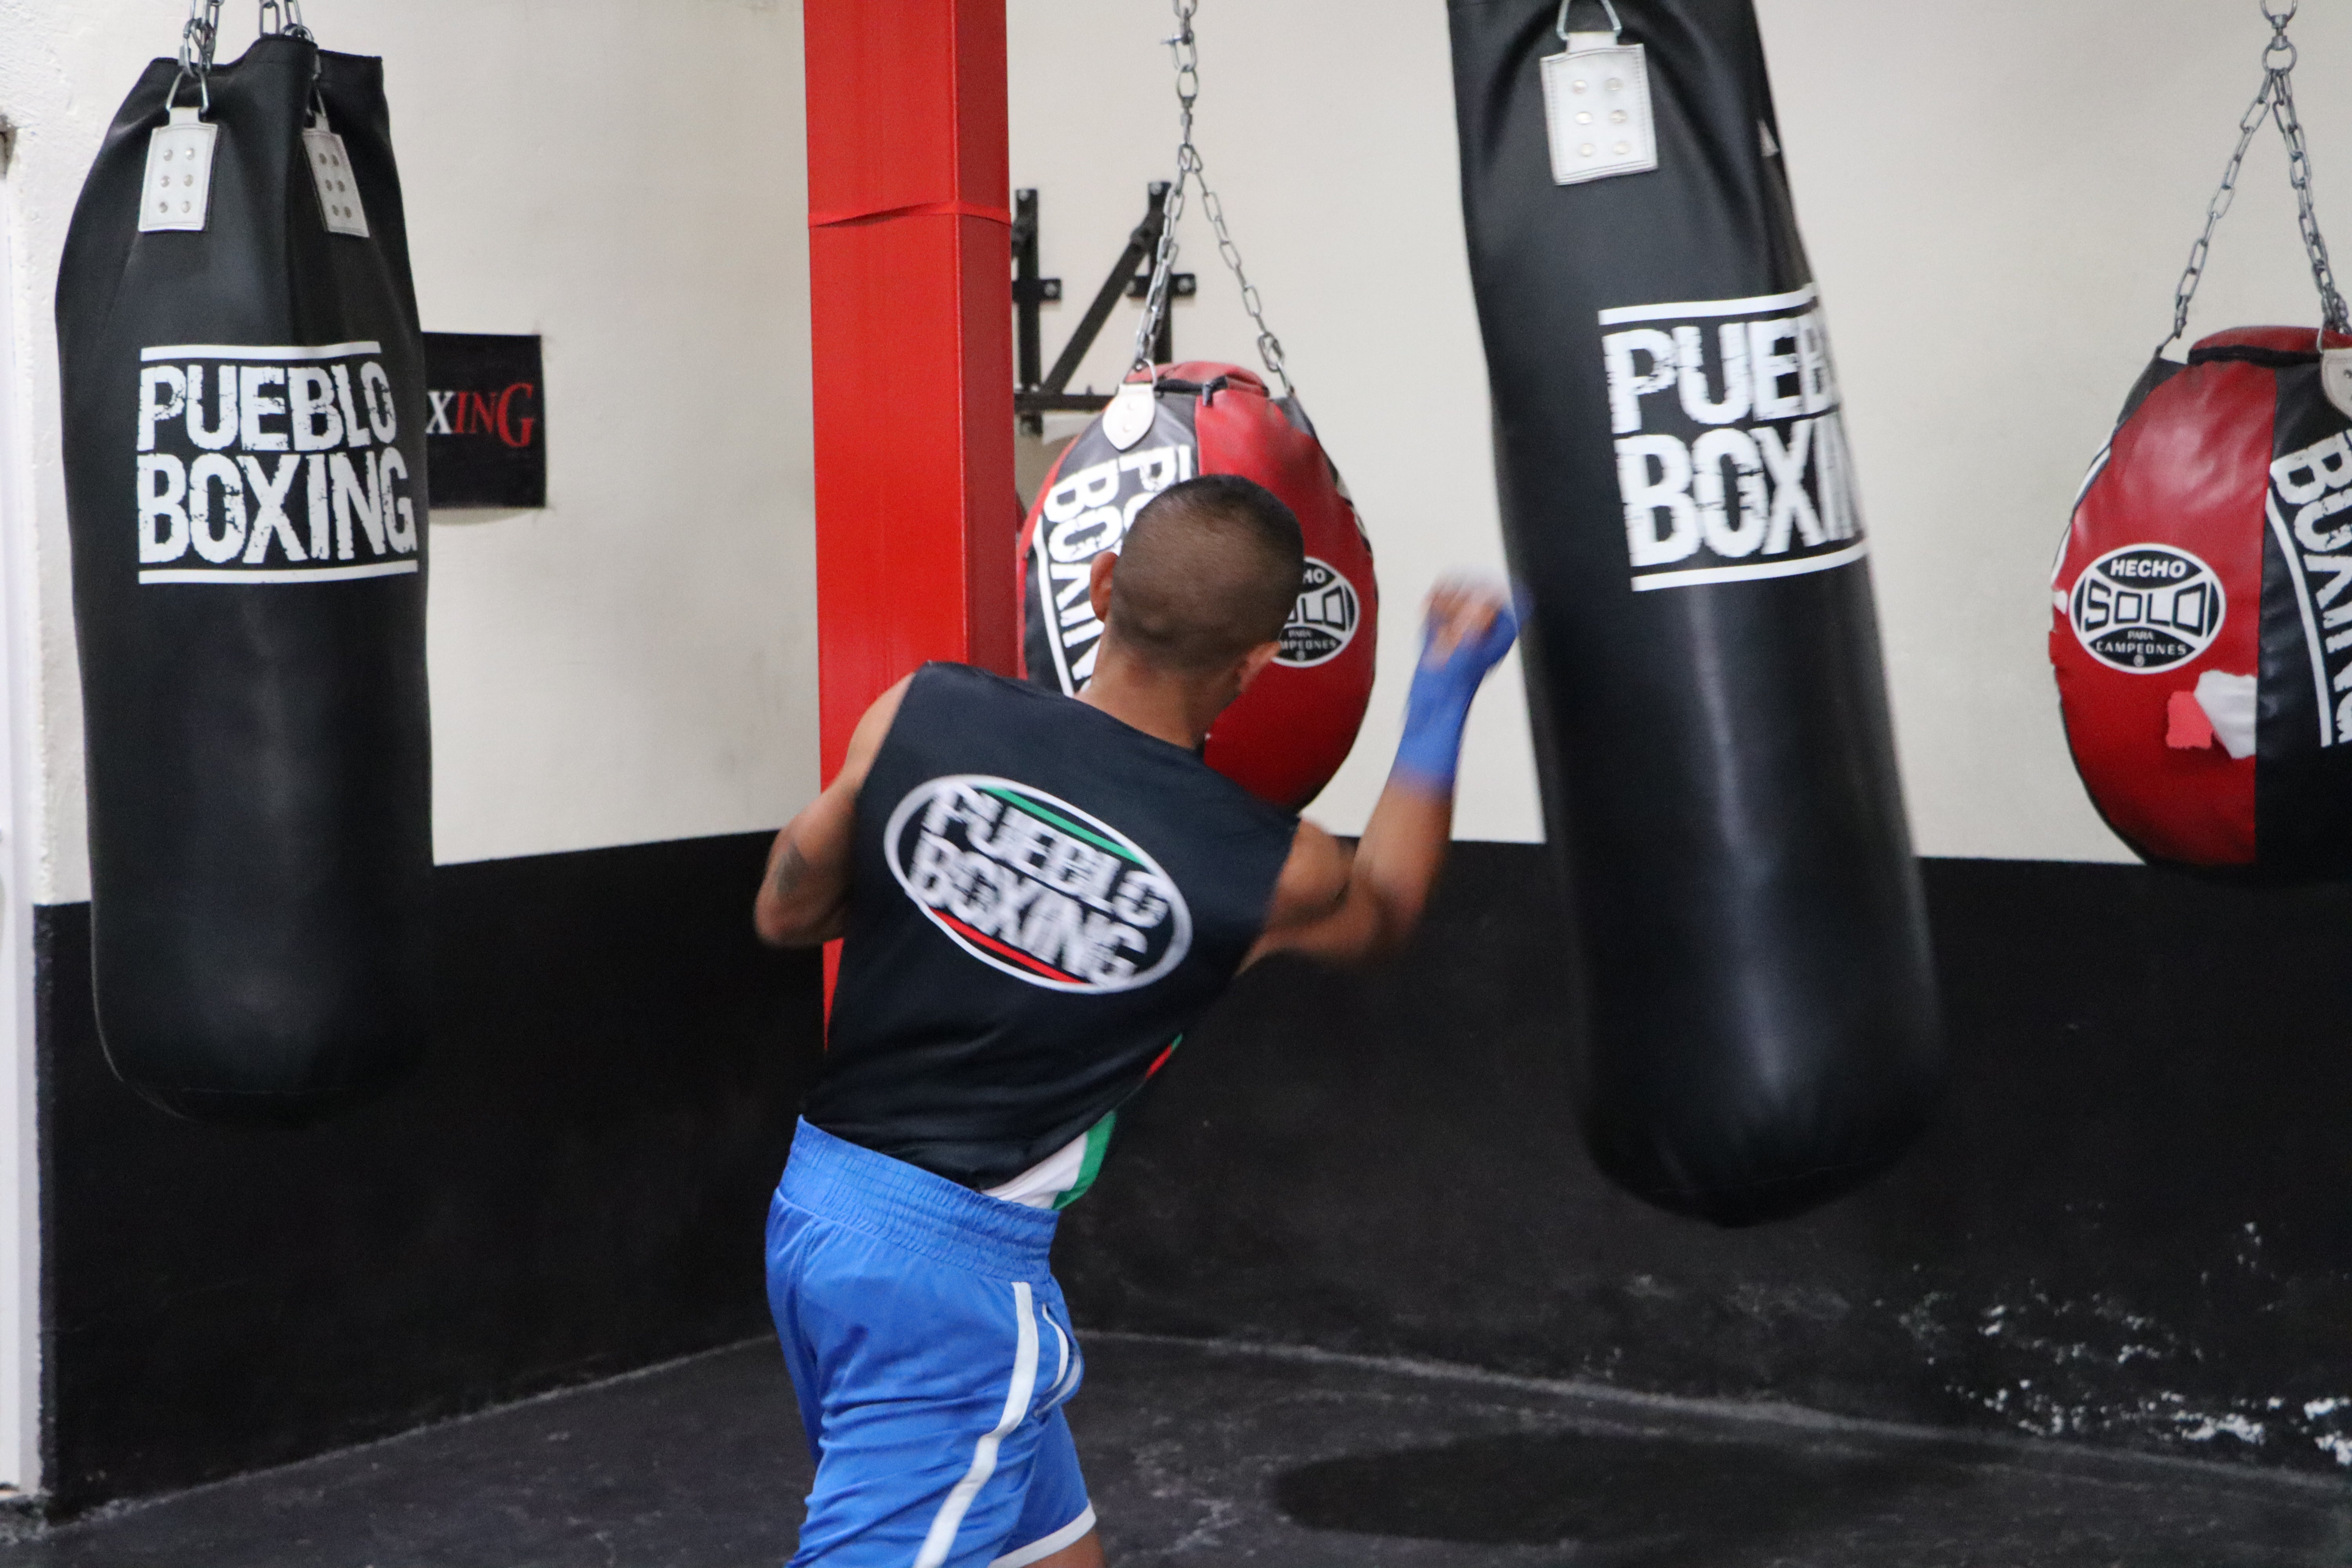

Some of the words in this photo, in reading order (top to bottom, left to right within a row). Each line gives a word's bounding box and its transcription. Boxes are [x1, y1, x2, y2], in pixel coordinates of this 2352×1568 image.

[137, 361, 396, 451] PUEBLO
[1602, 312, 1839, 434] PUEB
[426, 382, 534, 447] XING
[137, 447, 418, 564] BOXING
[1614, 418, 1857, 567] BOXI
[2110, 559, 2187, 578] HECHO
[1279, 639, 1337, 650] MPEONES
[2085, 579, 2207, 637] SOLO
[2127, 630, 2154, 640] PARA
[2096, 641, 2187, 655] CAMPEONES
[922, 784, 1168, 928] PUEBLO
[908, 829, 1148, 986] BOXING
